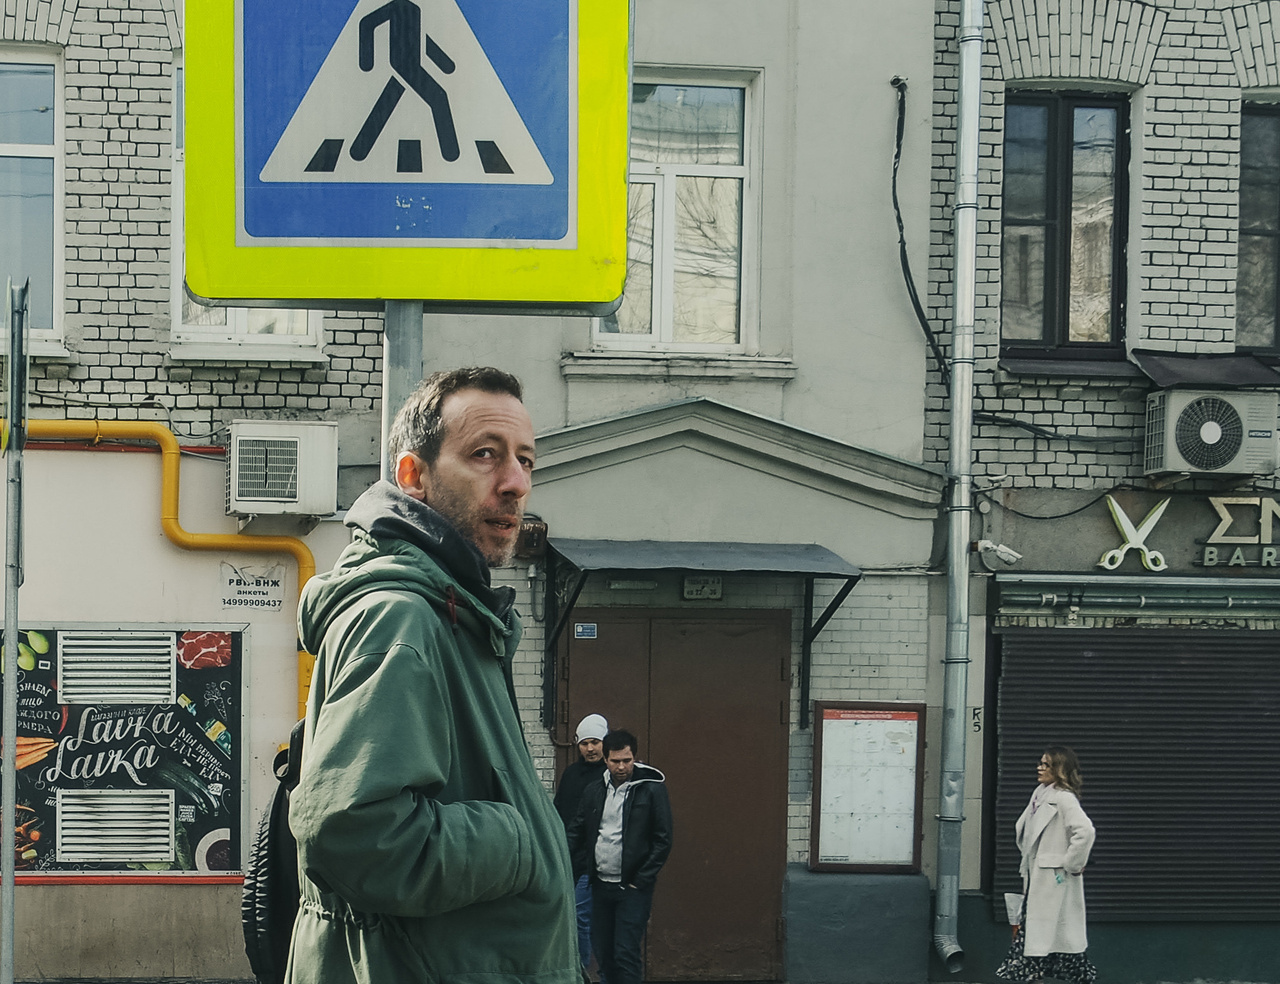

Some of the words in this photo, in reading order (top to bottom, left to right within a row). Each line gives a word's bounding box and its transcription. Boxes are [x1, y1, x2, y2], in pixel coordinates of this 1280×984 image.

[1203, 546, 1278, 567] BAR
[17, 709, 61, 720] ЖДОГО
[17, 721, 53, 734] РМЕРА
[66, 704, 180, 751] Lavka
[46, 735, 160, 786] Lavka
